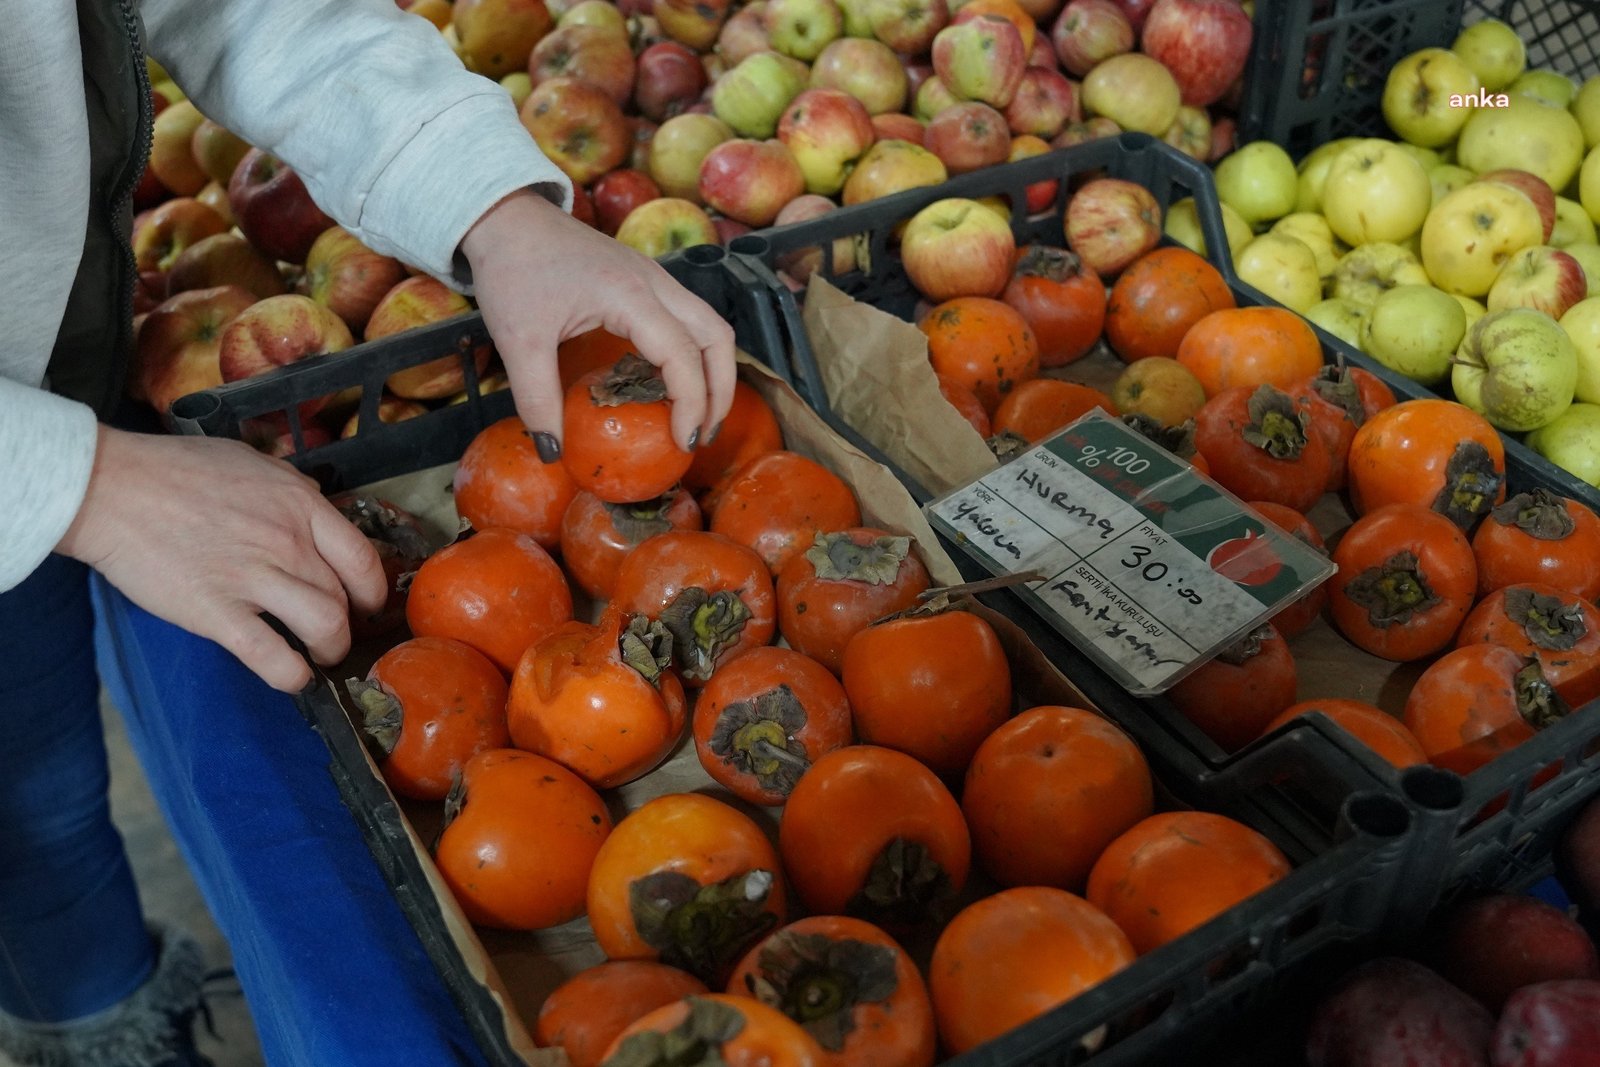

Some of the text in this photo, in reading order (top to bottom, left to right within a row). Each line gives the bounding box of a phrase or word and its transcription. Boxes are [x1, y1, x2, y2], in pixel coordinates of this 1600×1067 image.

[1077, 445, 1150, 475] %100
[972, 486, 996, 505] YÖRE
[1140, 525, 1168, 546] FİYAT
